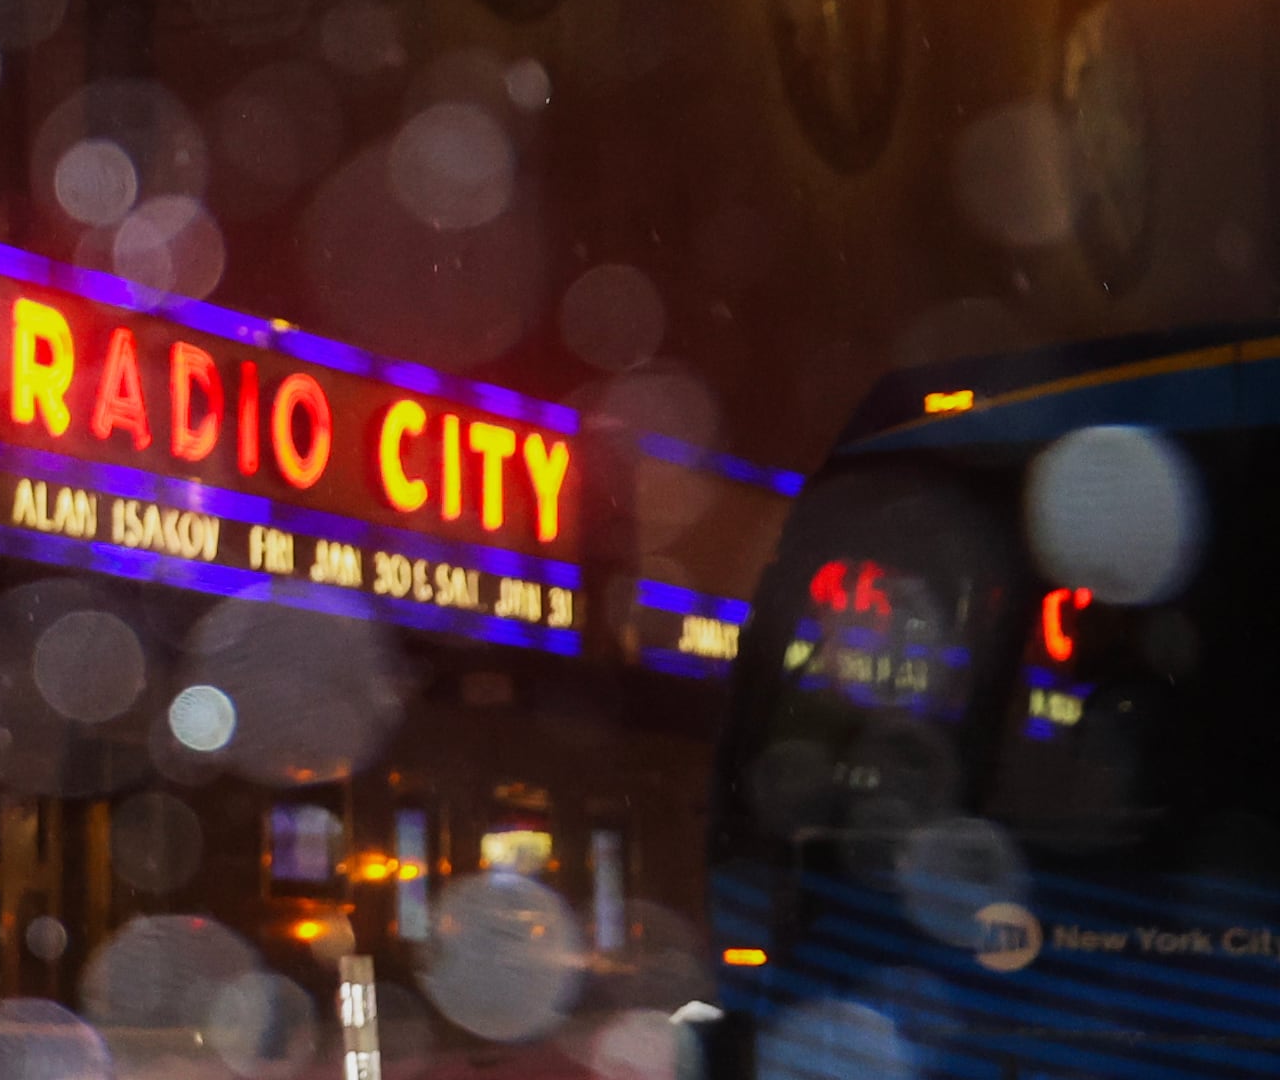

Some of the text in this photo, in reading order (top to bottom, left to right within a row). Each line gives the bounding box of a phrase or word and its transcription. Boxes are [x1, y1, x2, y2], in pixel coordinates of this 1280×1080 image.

[10, 296, 333, 490] RADIO
[379, 398, 571, 543] CITY
[11, 477, 98, 539] ALAN
[111, 497, 221, 562] ISAKOV
[249, 523, 295, 575] FRI
[309, 538, 363, 588] JAN
[1052, 923, 1129, 952] New
[1136, 924, 1214, 955] York
